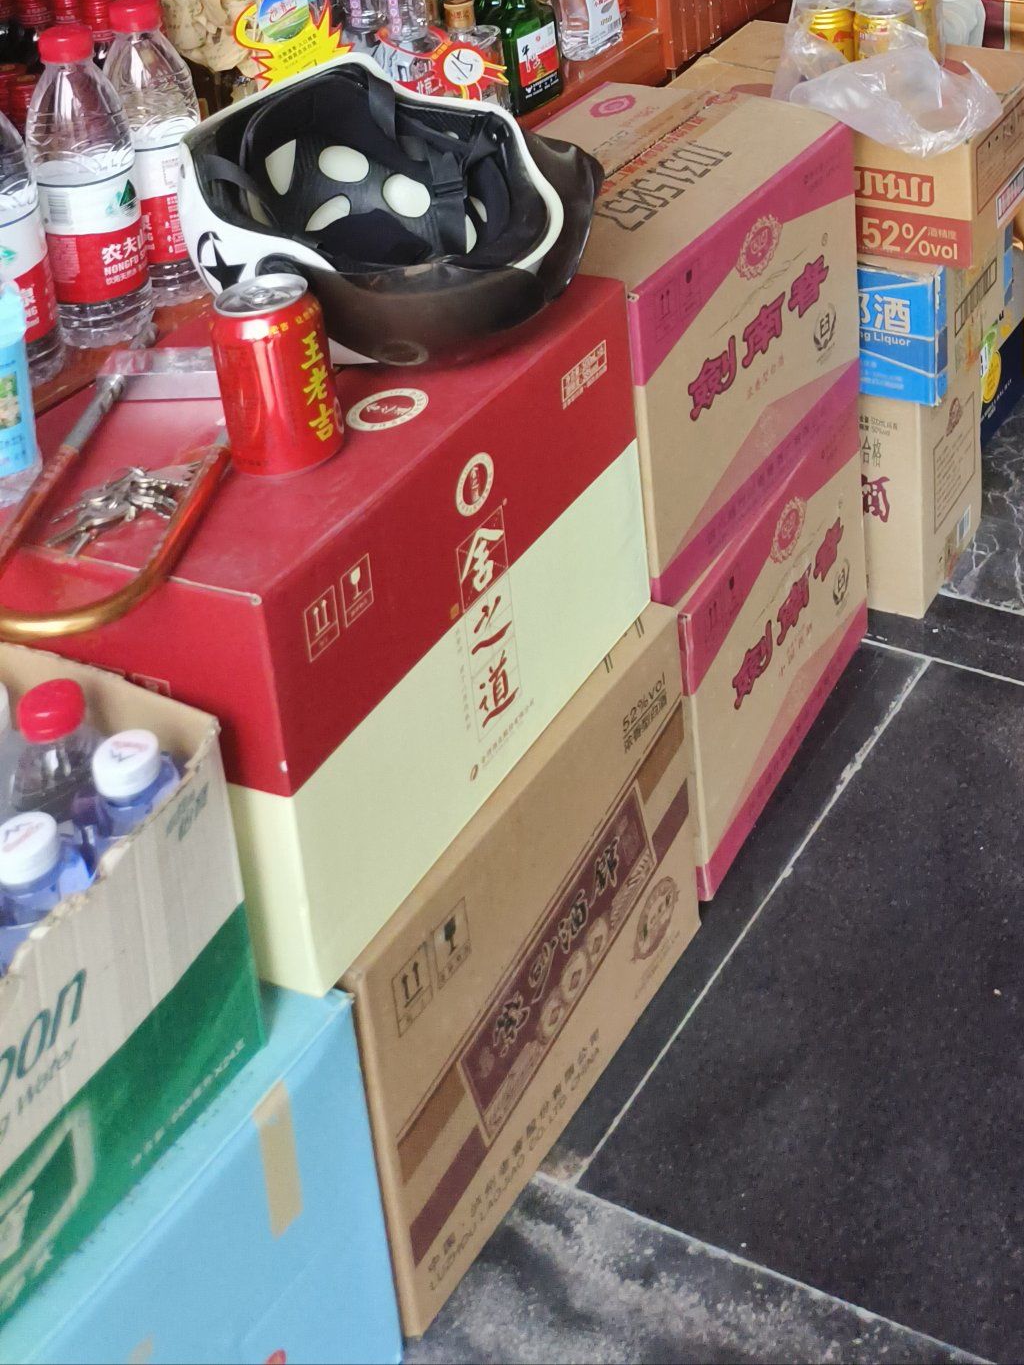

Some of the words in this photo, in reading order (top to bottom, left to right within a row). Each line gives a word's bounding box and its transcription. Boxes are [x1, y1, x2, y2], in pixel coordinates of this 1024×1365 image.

[300, 332, 336, 442] 王老吉
[687, 254, 830, 422] 剑南春
[873, 330, 911, 347] Liquor
[461, 526, 519, 729] 舍之道
[622, 672, 667, 732] 52%vol
